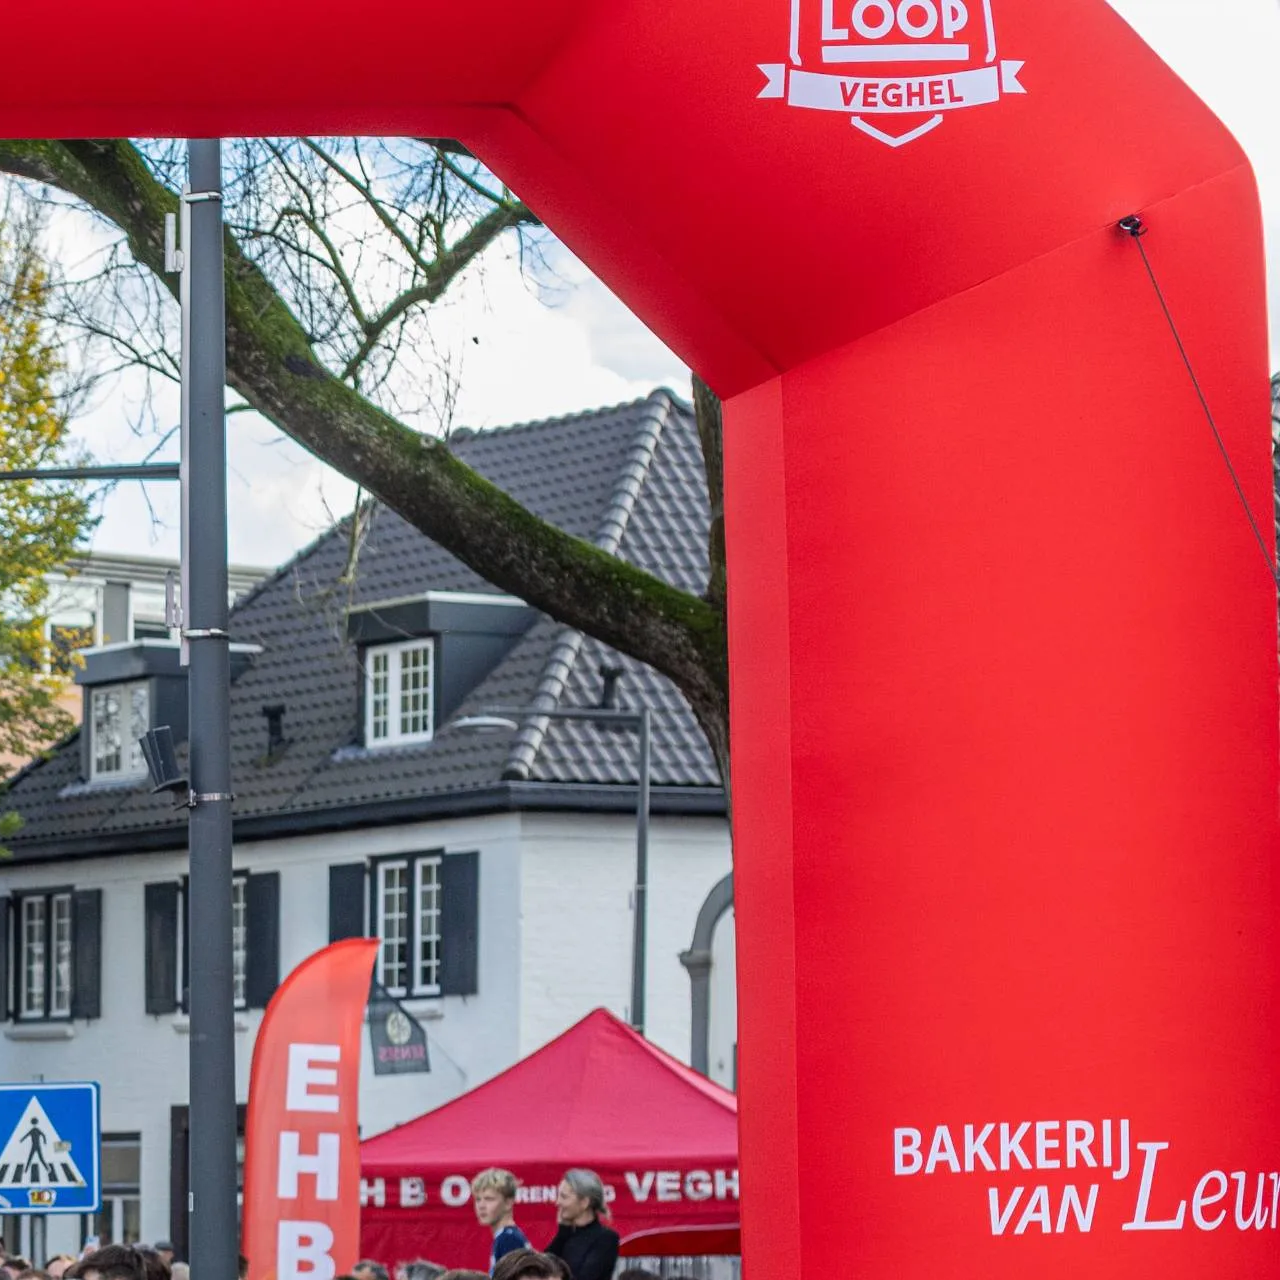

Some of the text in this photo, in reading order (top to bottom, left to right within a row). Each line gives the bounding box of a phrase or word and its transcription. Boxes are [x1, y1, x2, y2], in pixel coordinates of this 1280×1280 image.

[821, 0, 968, 40] LOOP
[840, 79, 964, 107] VEGHEL
[893, 1118, 1130, 1180] BAKKERIJ
[624, 1169, 738, 1203] VEGH
[988, 1183, 1100, 1235] VAN
